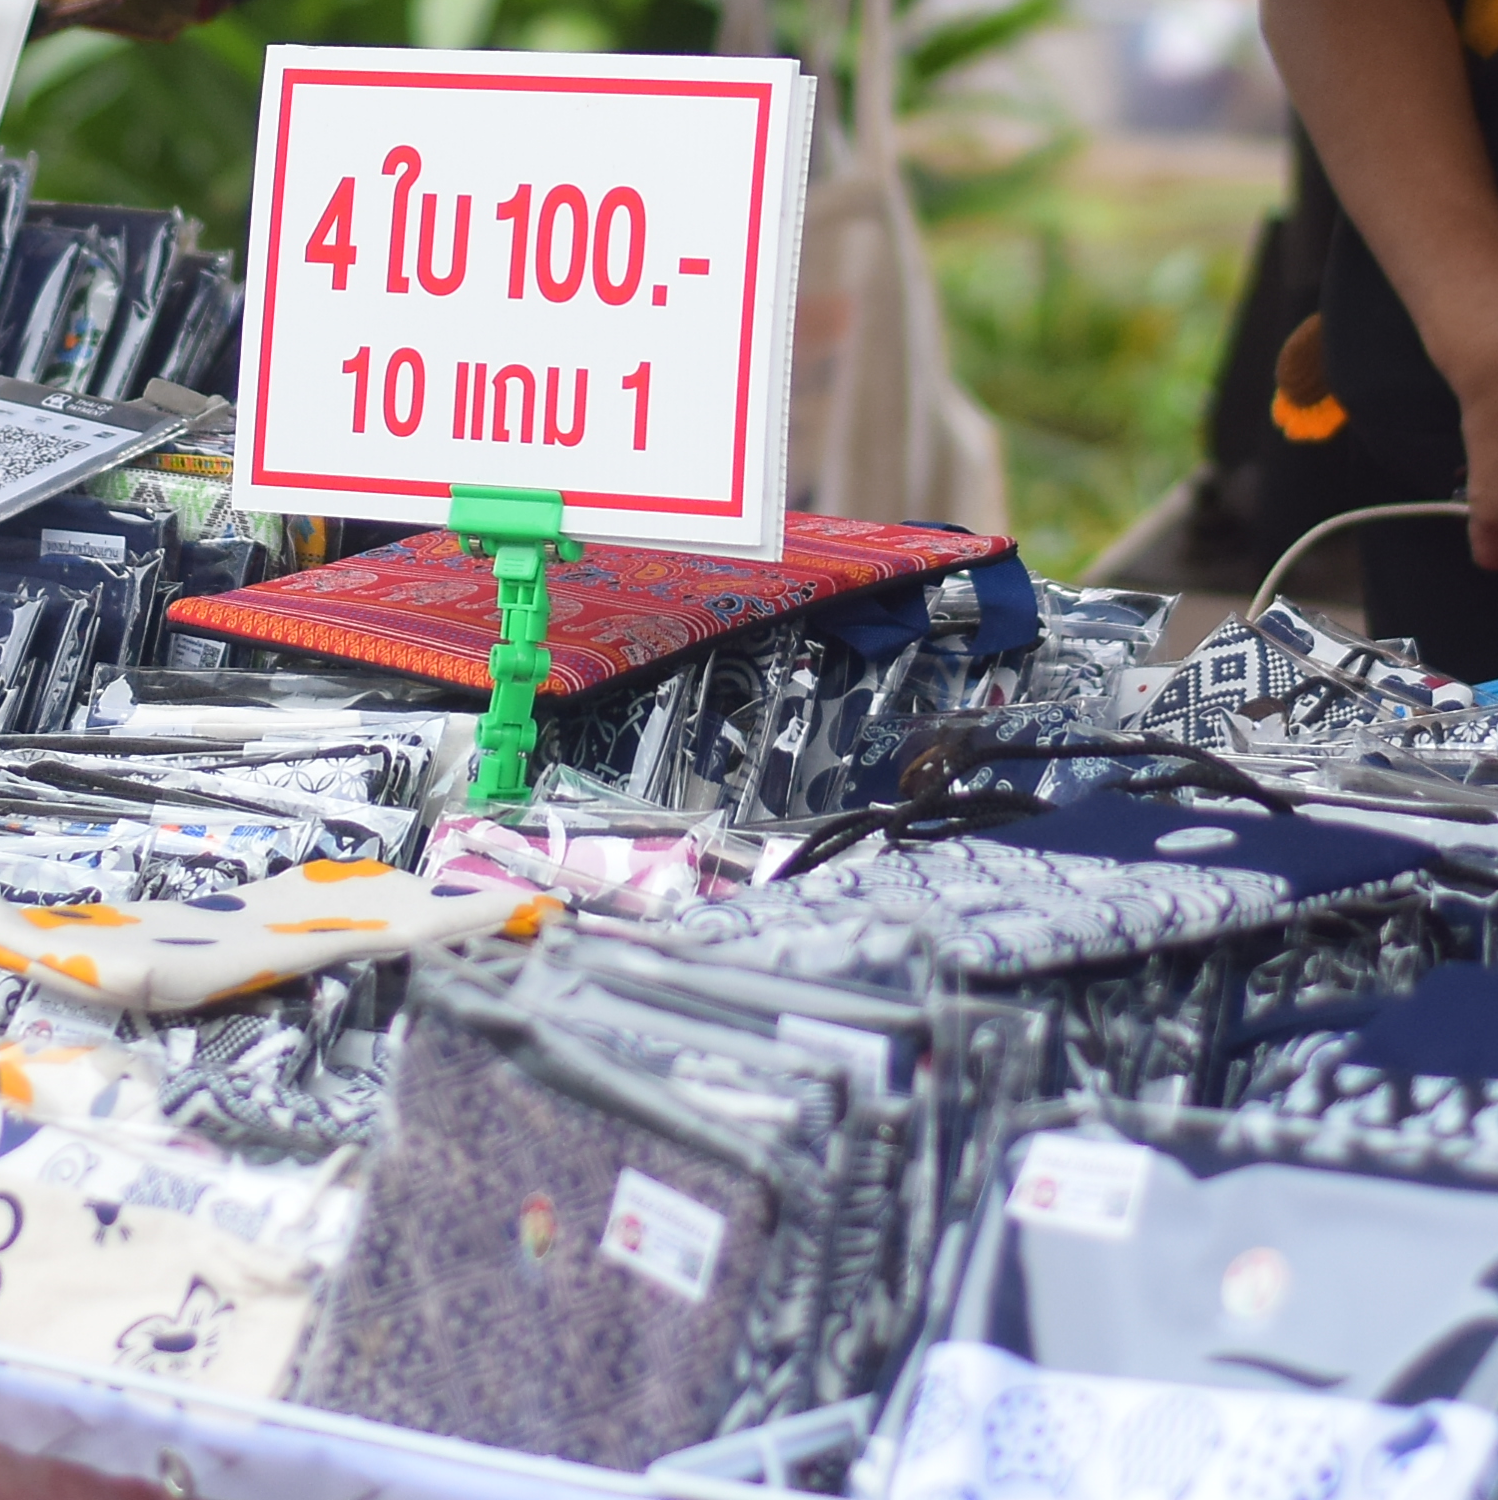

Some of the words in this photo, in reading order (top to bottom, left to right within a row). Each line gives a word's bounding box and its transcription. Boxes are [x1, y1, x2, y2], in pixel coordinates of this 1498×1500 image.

[304, 176, 358, 292] 4
[381, 144, 473, 297] ใบ
[496, 183, 711, 308] 100.-
[66, 404, 107, 417] PAYMENT
[341, 346, 426, 438] 10
[452, 361, 590, 448] แถม
[622, 361, 652, 452] 1
